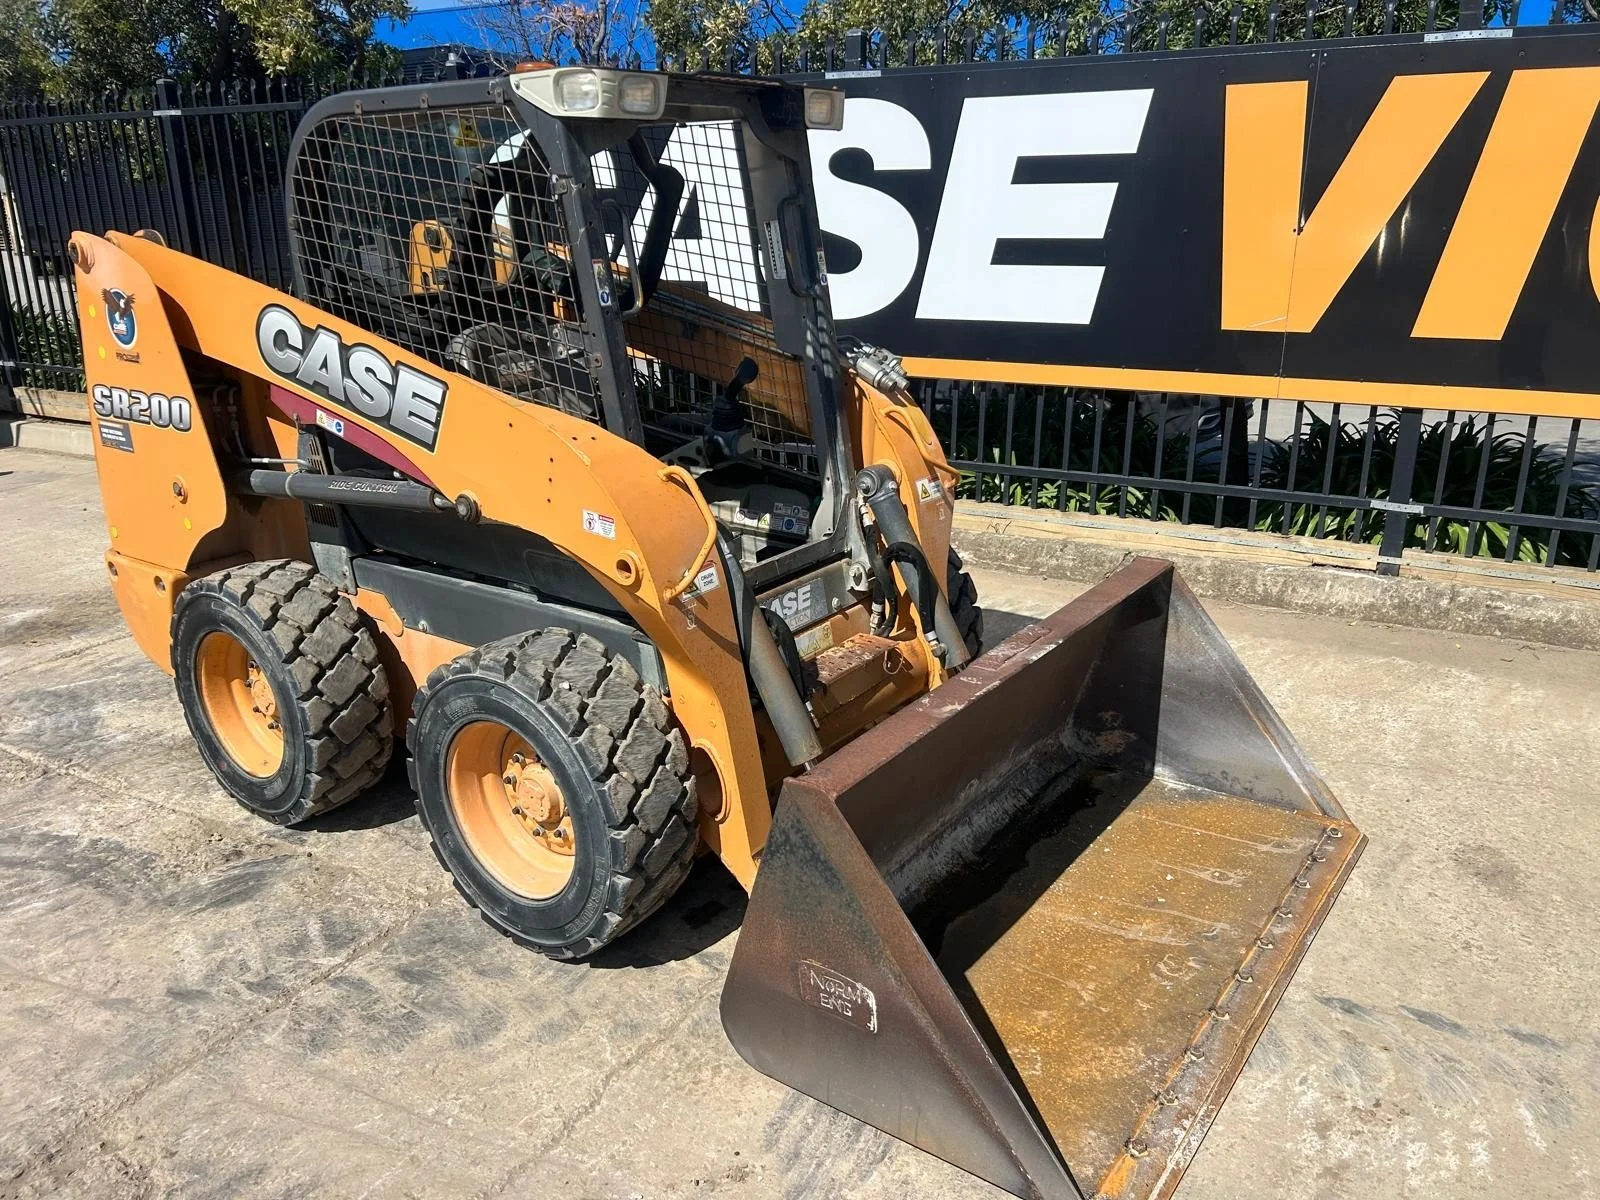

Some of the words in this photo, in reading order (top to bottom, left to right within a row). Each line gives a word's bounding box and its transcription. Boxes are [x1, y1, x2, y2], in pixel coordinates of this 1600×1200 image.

[1221, 66, 1600, 341] VI
[256, 304, 448, 453] CASE
[92, 384, 192, 433] SR200
[328, 479, 352, 490] RIDE
[353, 481, 399, 494] CONTROL
[700, 572, 715, 582] CRUSH
[703, 578, 715, 587] ZONE
[770, 584, 811, 618] ASE
[810, 969, 861, 1004] NORM
[820, 992, 852, 1016] ENG
